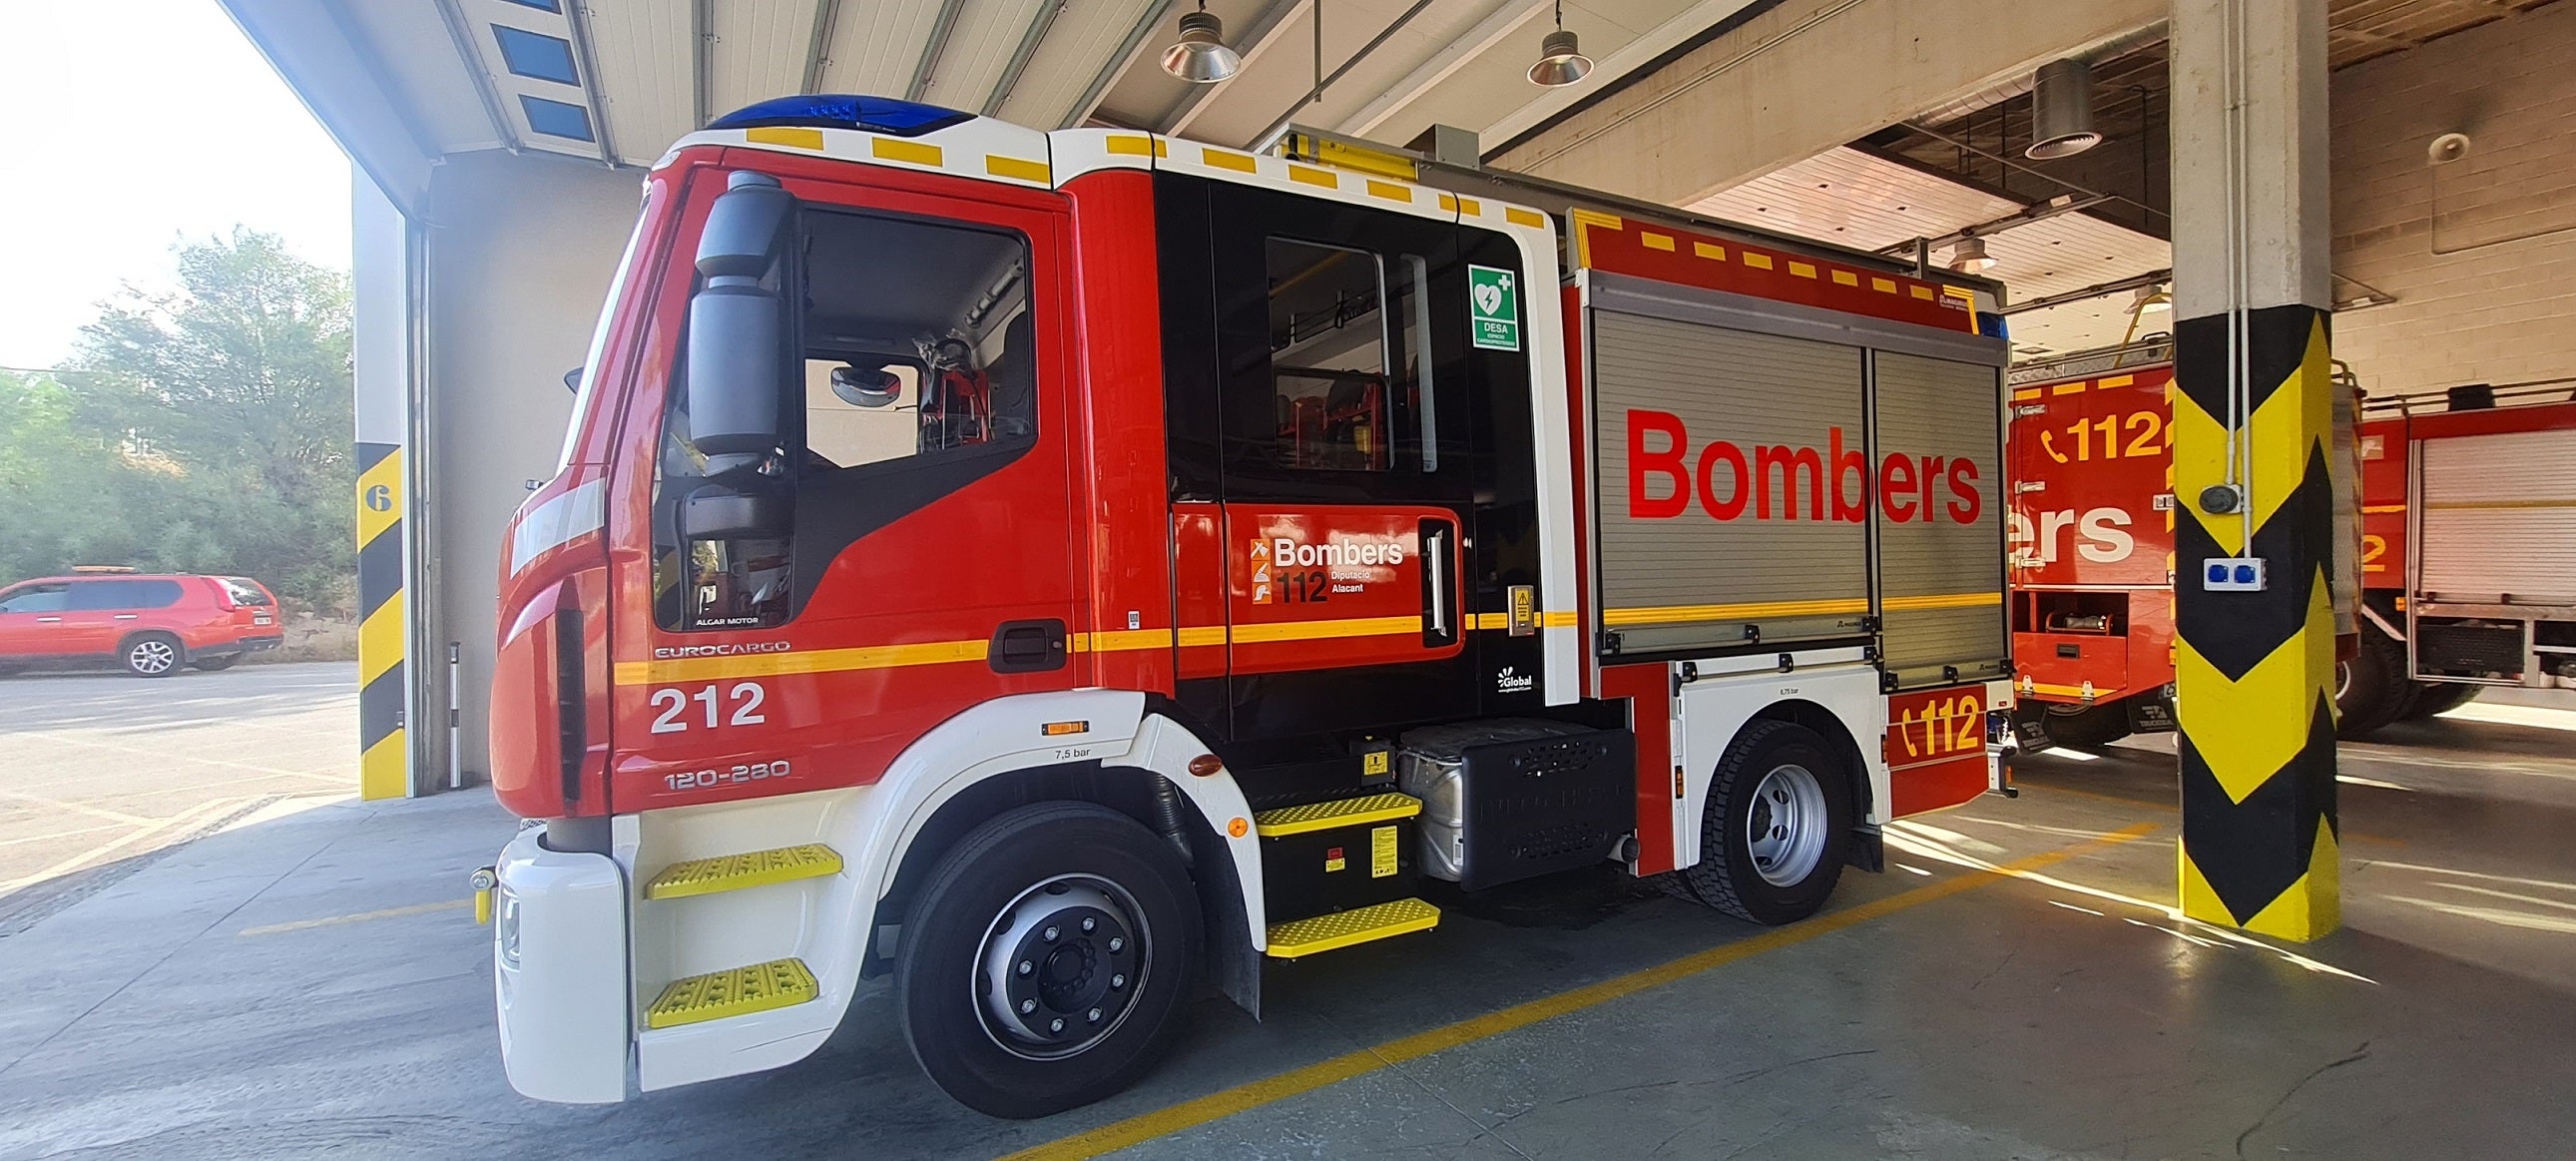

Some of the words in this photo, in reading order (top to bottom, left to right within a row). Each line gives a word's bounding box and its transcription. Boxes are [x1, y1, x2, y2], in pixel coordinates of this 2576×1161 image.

[1484, 322, 1508, 333] DESA
[2067, 411, 2162, 461] 112
[1627, 408, 1981, 525] Bombers
[366, 485, 391, 511] 6
[1274, 538, 1403, 567] Bombers
[1277, 571, 1327, 604] 112
[1331, 583, 1363, 593] Alacant
[655, 640, 791, 659] EUROCARGO
[1503, 675, 1532, 688] Global
[651, 682, 766, 734] 212
[1920, 695, 1979, 756] 112
[1055, 749, 1071, 760] 7,5
[1073, 748, 1091, 758] bar
[664, 760, 790, 791] 120-280
